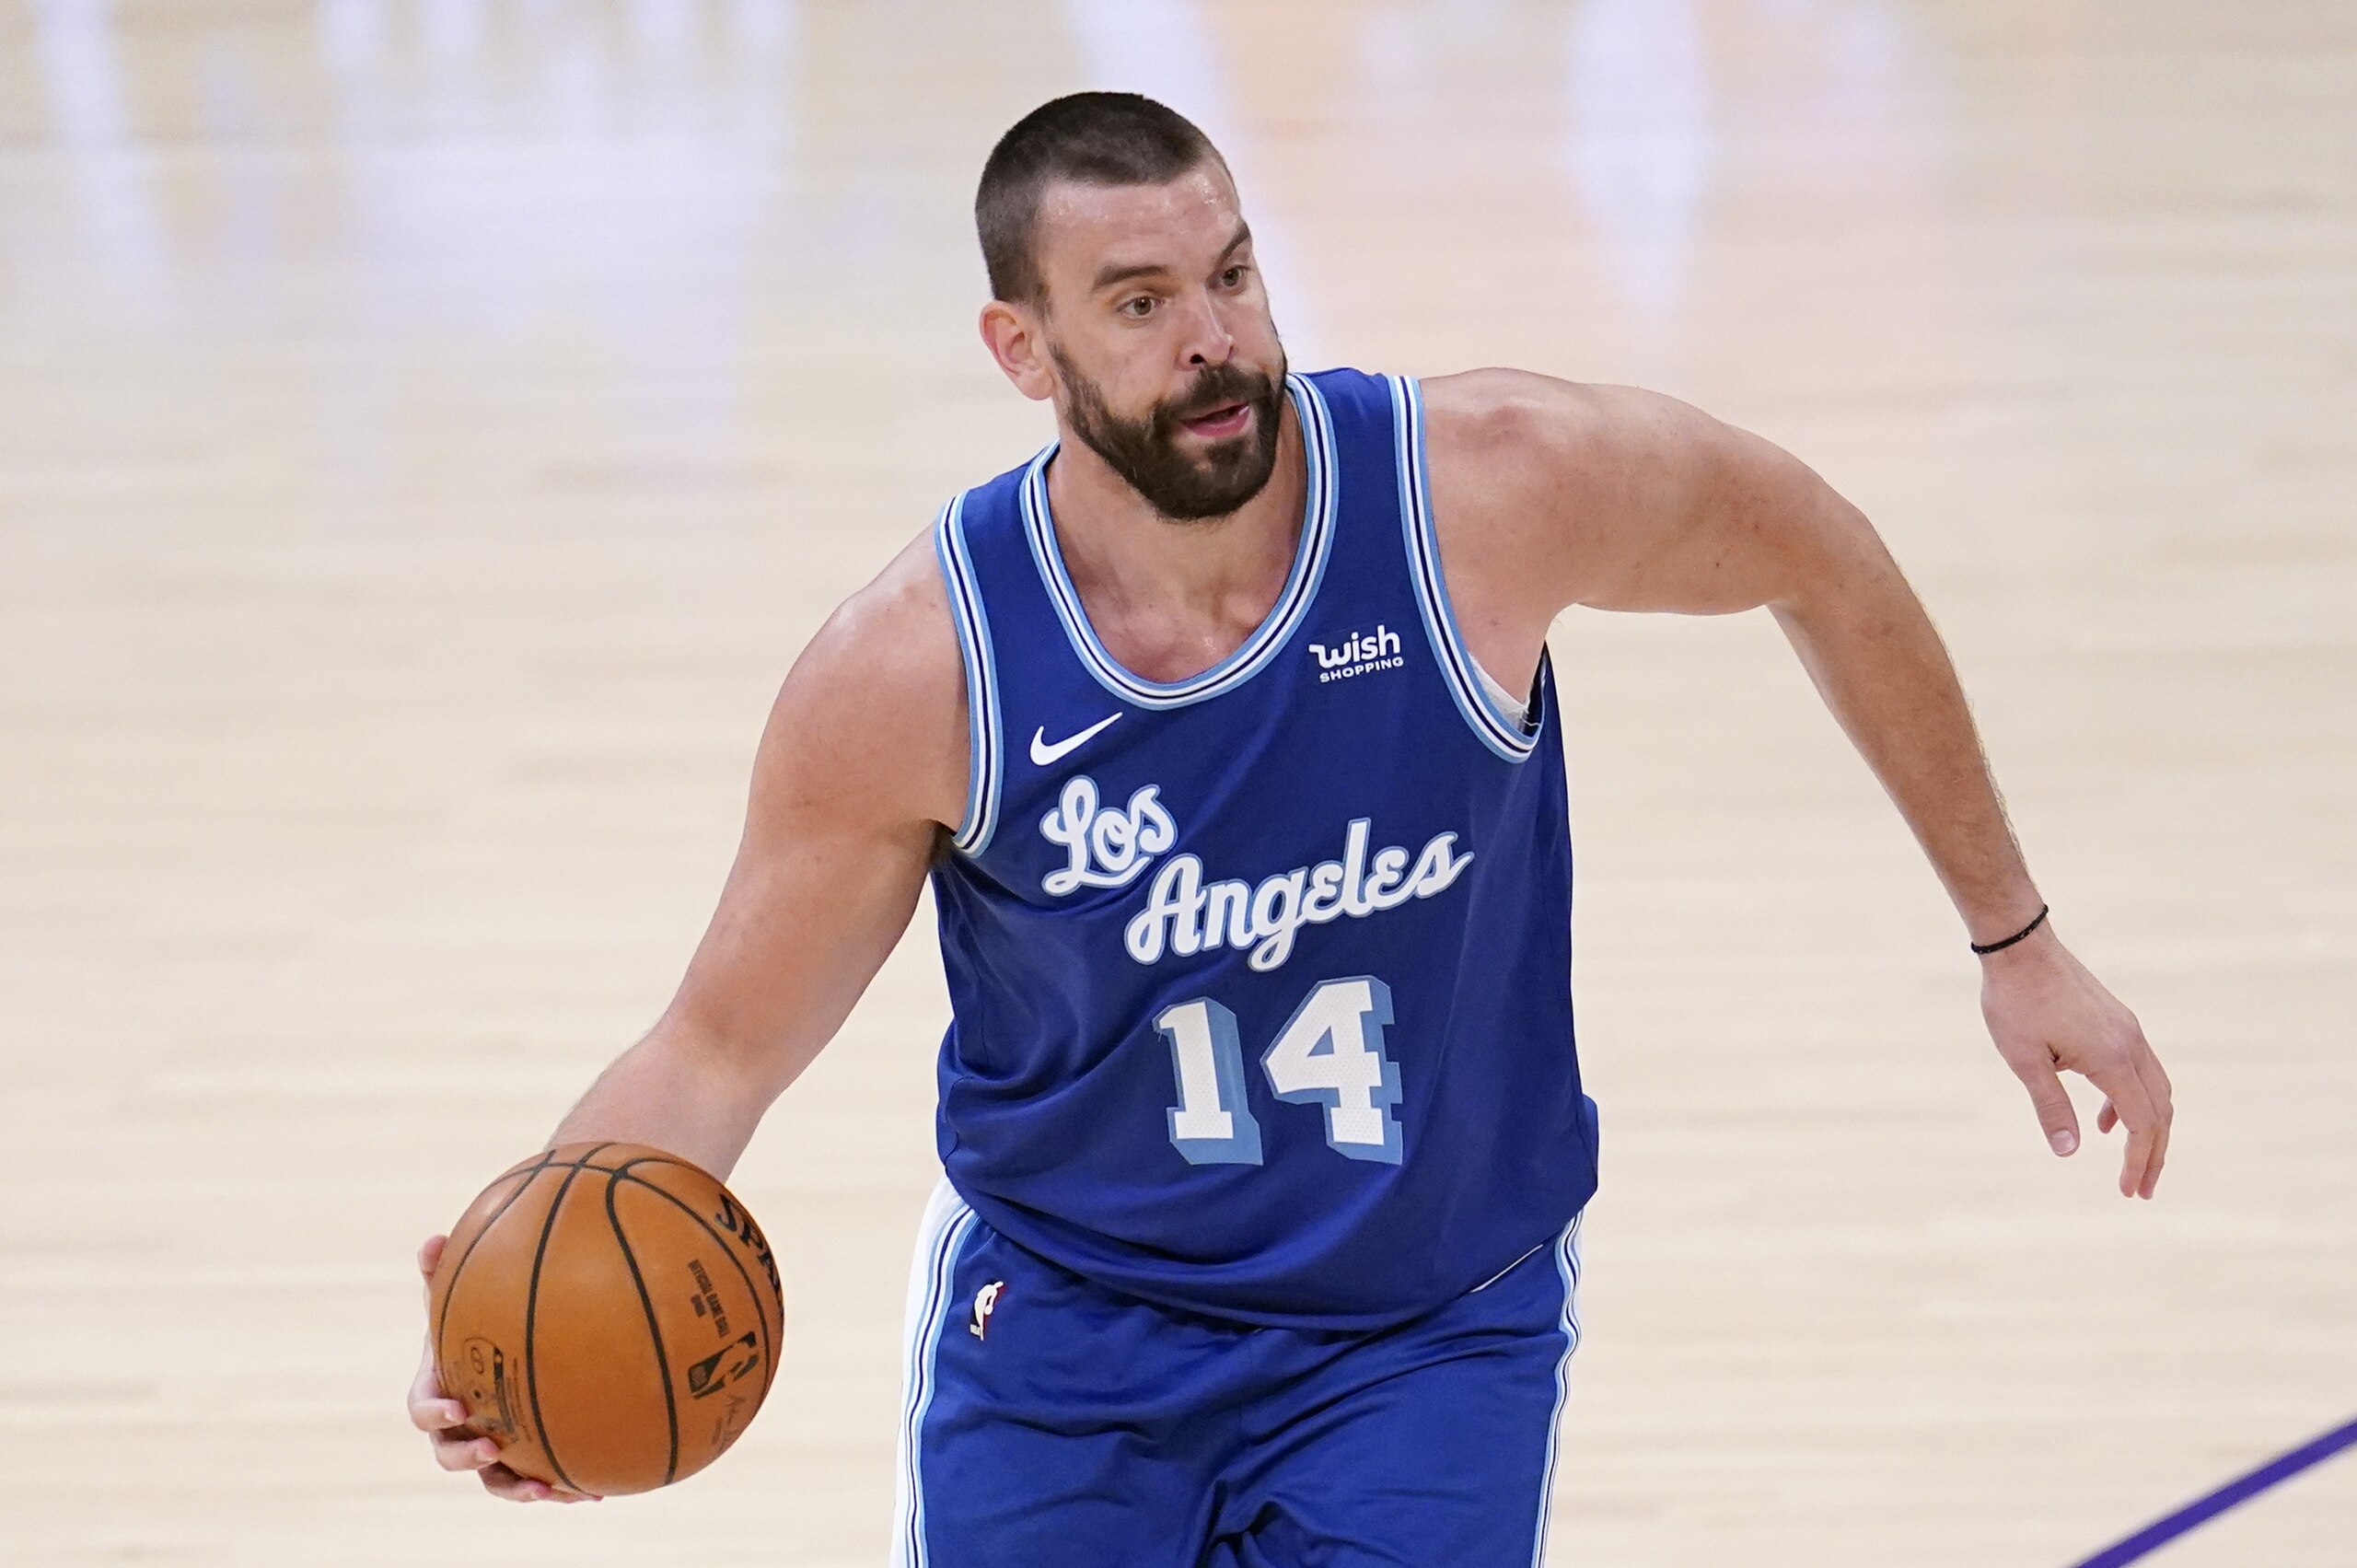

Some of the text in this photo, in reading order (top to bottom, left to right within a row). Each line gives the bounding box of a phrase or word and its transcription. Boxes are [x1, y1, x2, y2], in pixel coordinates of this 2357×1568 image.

[1308, 624, 1400, 668] wish
[1319, 656, 1404, 683] SHOPPING
[1040, 775, 1178, 897] Los
[1124, 818, 1474, 971] Angeles
[1152, 975, 1403, 1166] 14
